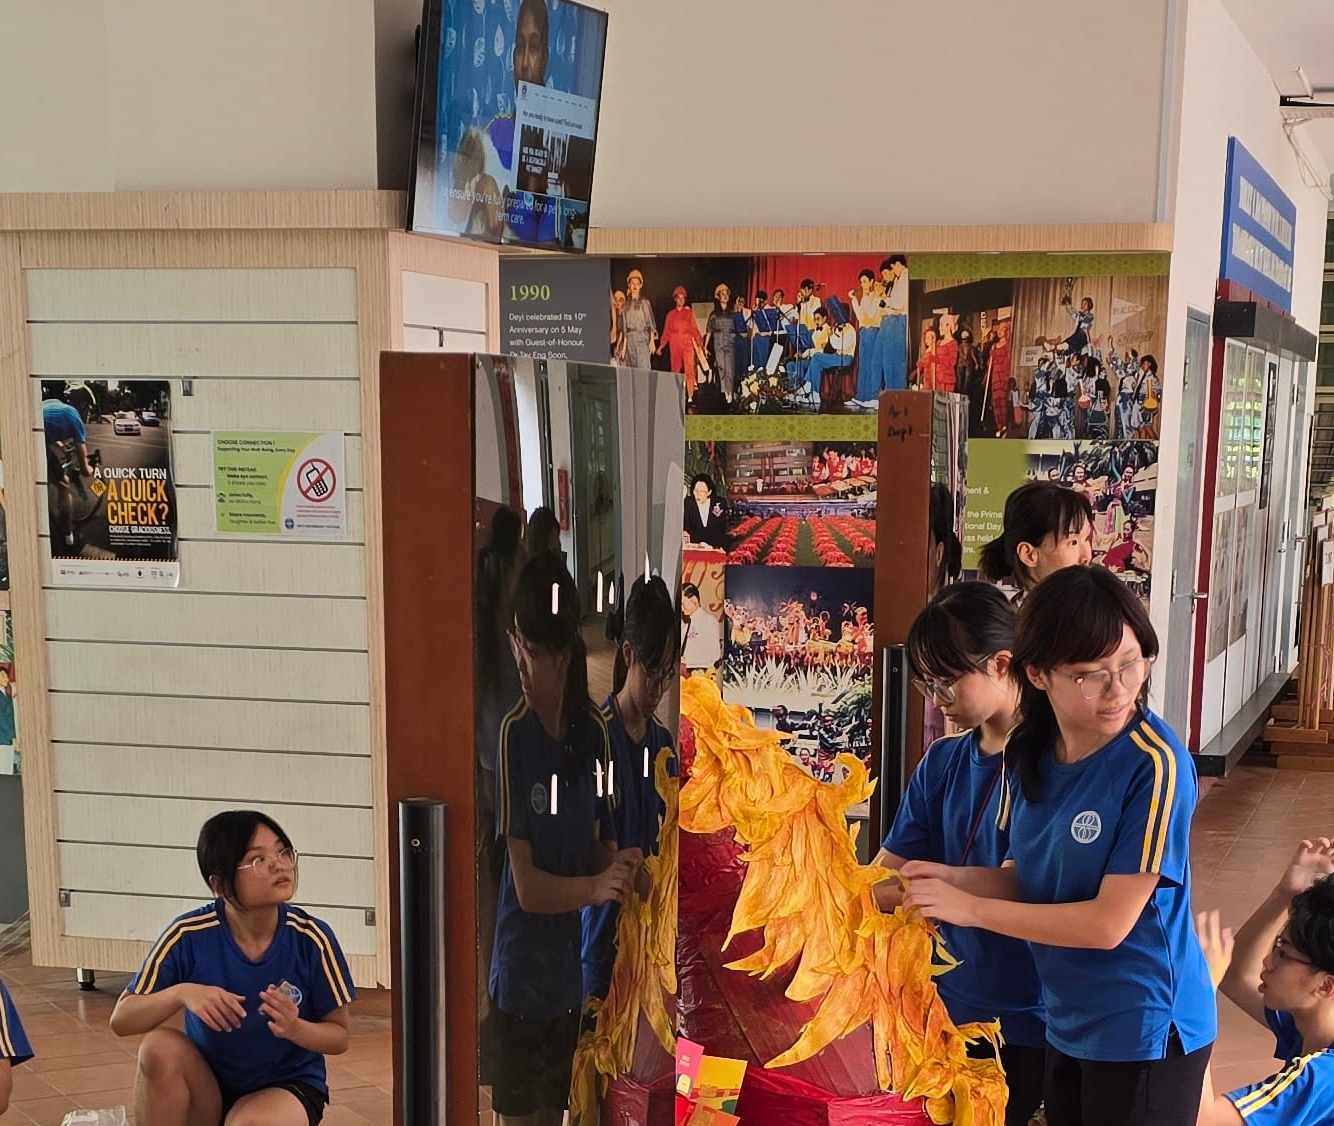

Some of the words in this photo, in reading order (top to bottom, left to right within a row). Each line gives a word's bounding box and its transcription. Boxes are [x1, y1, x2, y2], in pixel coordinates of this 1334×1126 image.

[450, 188, 471, 201] ensure
[510, 284, 551, 301] 1990
[509, 312, 525, 322] Deyi
[525, 312, 562, 321] celebrated
[563, 313, 572, 321] its
[509, 325, 549, 335] Anniversary
[567, 325, 583, 335] May
[509, 338, 524, 346] with
[93, 468, 102, 479] A
[104, 467, 136, 479] QUICK
[138, 467, 167, 480] TURN
[94, 482, 104, 493] OR
[107, 479, 118, 501] A
[120, 479, 169, 502] QUICK
[983, 486, 990, 495] &
[107, 502, 169, 526] CHECK?
[967, 510, 979, 518] the
[981, 510, 1003, 518] Prime
[986, 522, 1002, 531] Day
